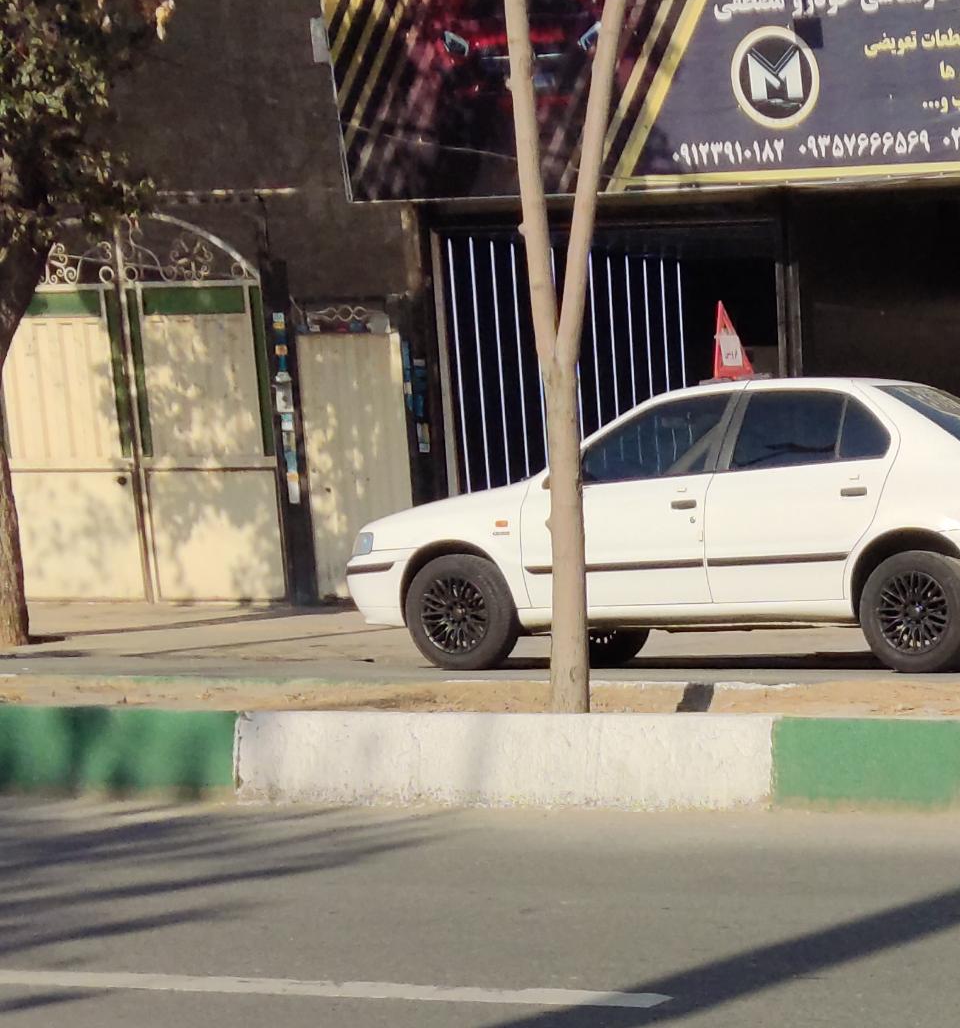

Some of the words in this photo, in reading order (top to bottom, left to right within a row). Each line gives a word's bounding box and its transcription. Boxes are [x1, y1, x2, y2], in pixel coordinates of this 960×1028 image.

[864, 30, 917, 57] تعویضی
[939, 60, 955, 80] ها
[672, 138, 785, 167] ۰۹۱۲۳۹۱۰۱۸۲
[799, 129, 930, 158] ۰۹۳۵۷۶۶۶۵۶۹
